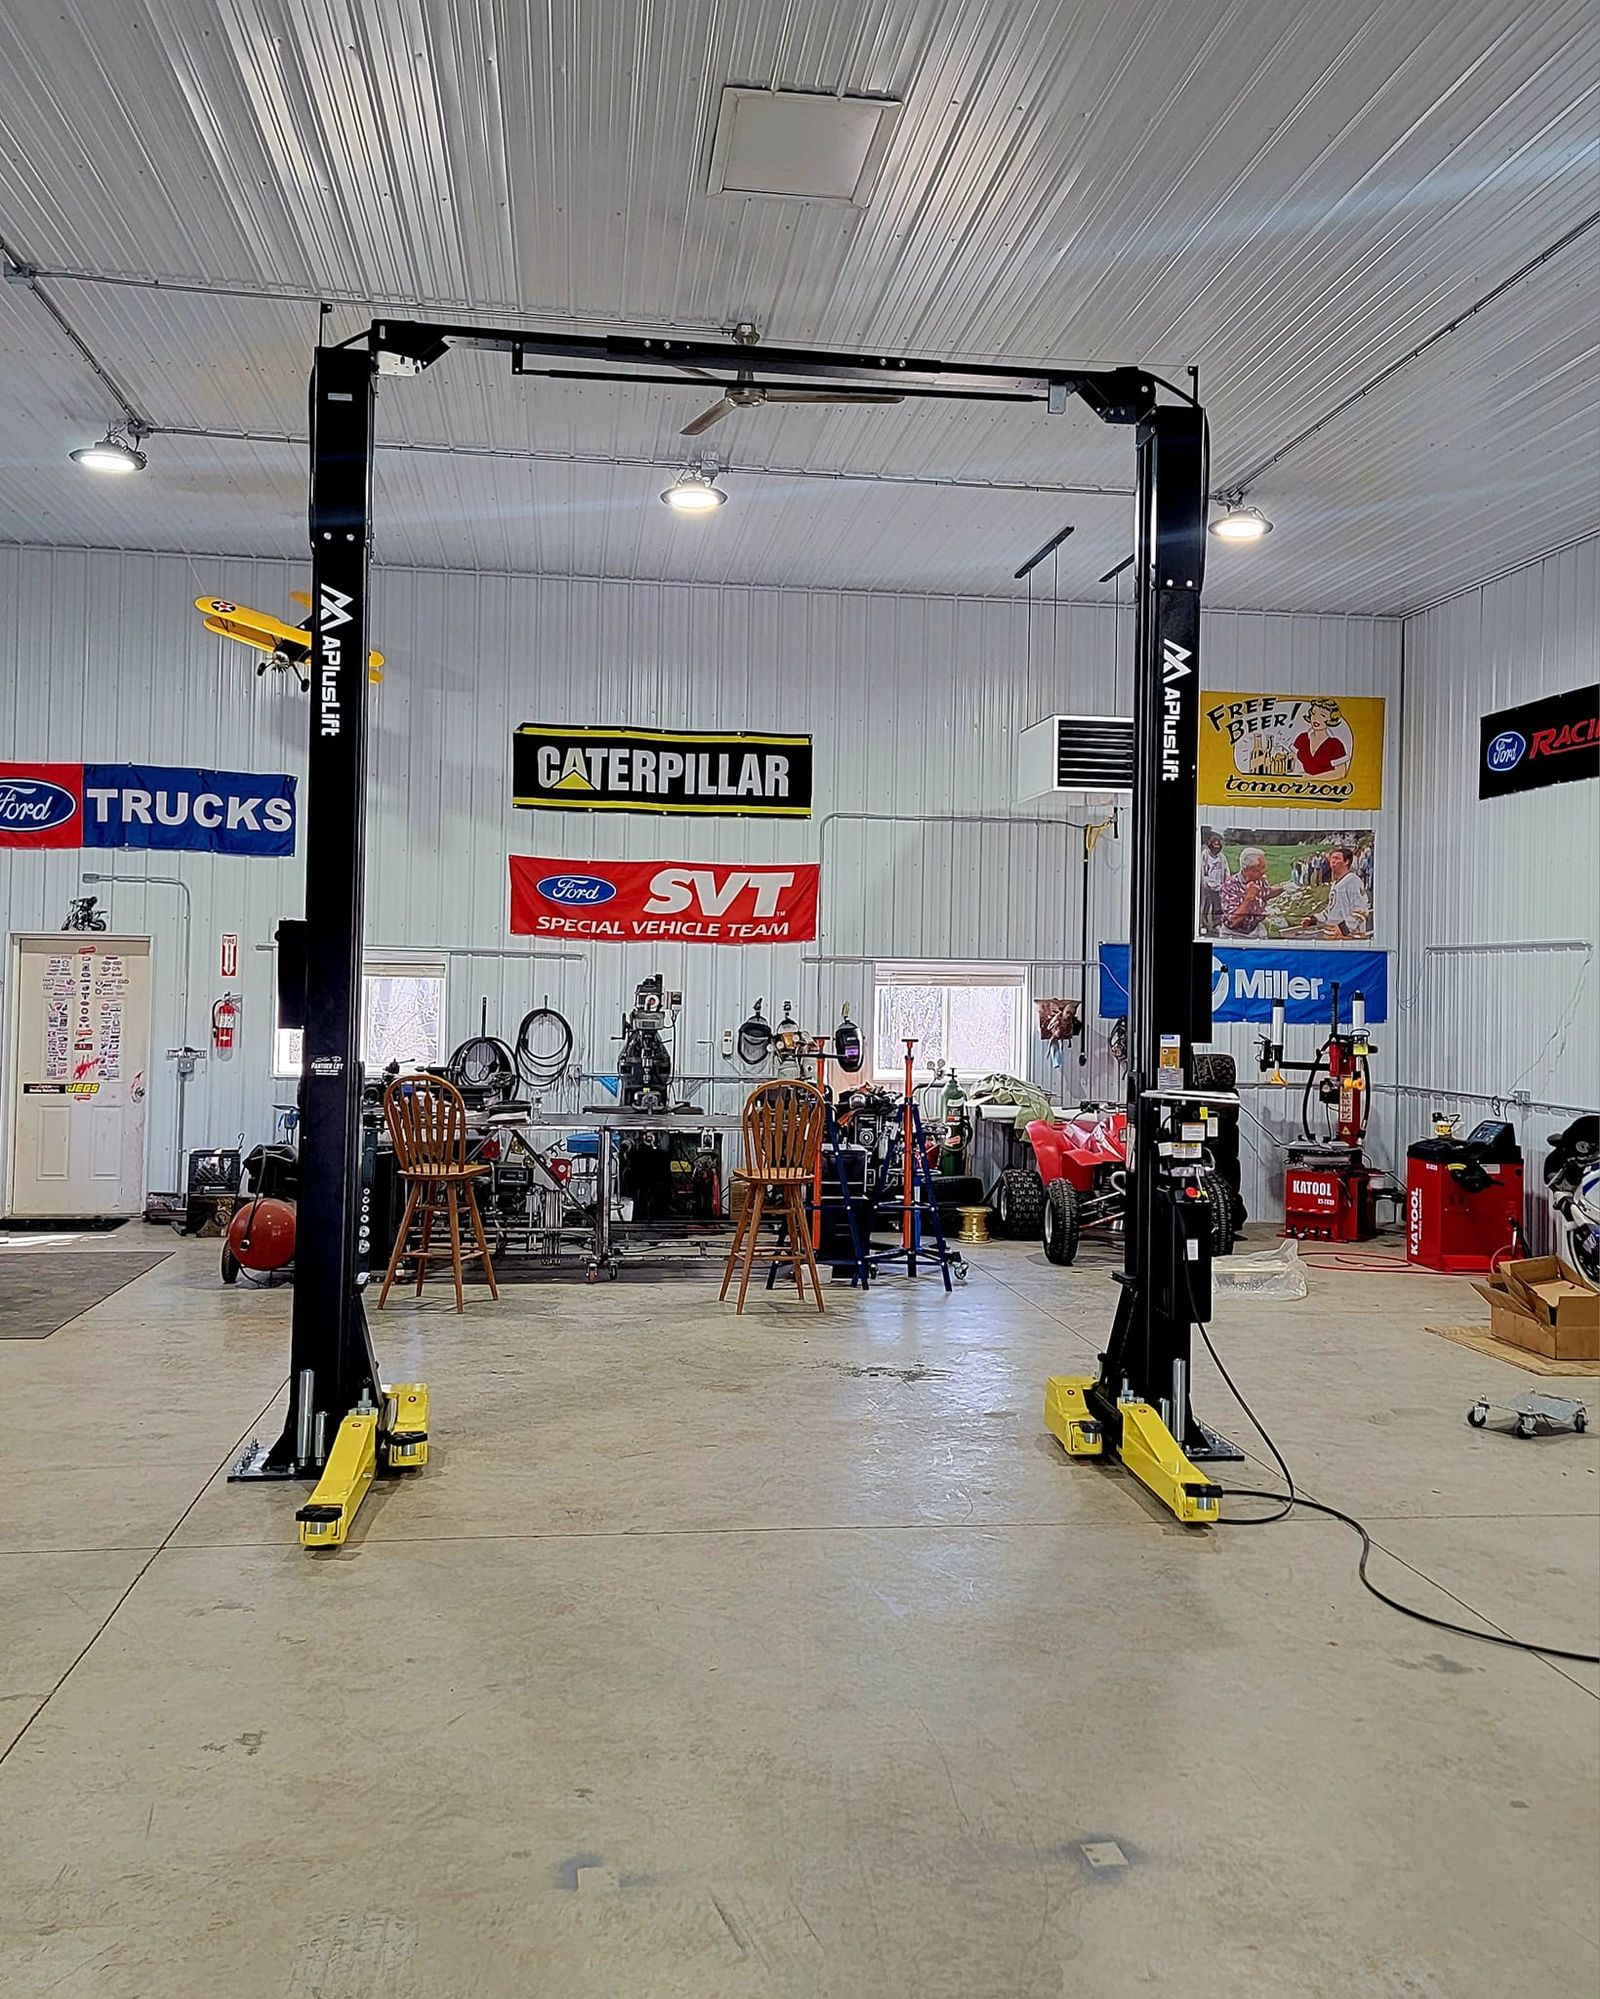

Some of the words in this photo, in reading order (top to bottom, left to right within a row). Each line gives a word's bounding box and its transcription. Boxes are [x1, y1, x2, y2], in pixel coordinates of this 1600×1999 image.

[1206, 697, 1277, 732] FREE
[1225, 702, 1302, 745] BEER!
[1493, 737, 1518, 765] Ford
[537, 746, 789, 797] CATERPILLAR
[1225, 774, 1354, 796] tomorrow
[86, 788, 293, 833] TRUCKS
[552, 877, 600, 900] Ford
[643, 868, 795, 918] SVT
[536, 916, 625, 935] SPECIAL
[631, 920, 721, 937] VEHICLE
[727, 922, 789, 937] TEAM
[1234, 968, 1324, 1000] Miller
[68, 1084, 100, 1094] JEGS
[1293, 1180, 1332, 1196] KATOOL
[1411, 1187, 1419, 1255] KATOOL
